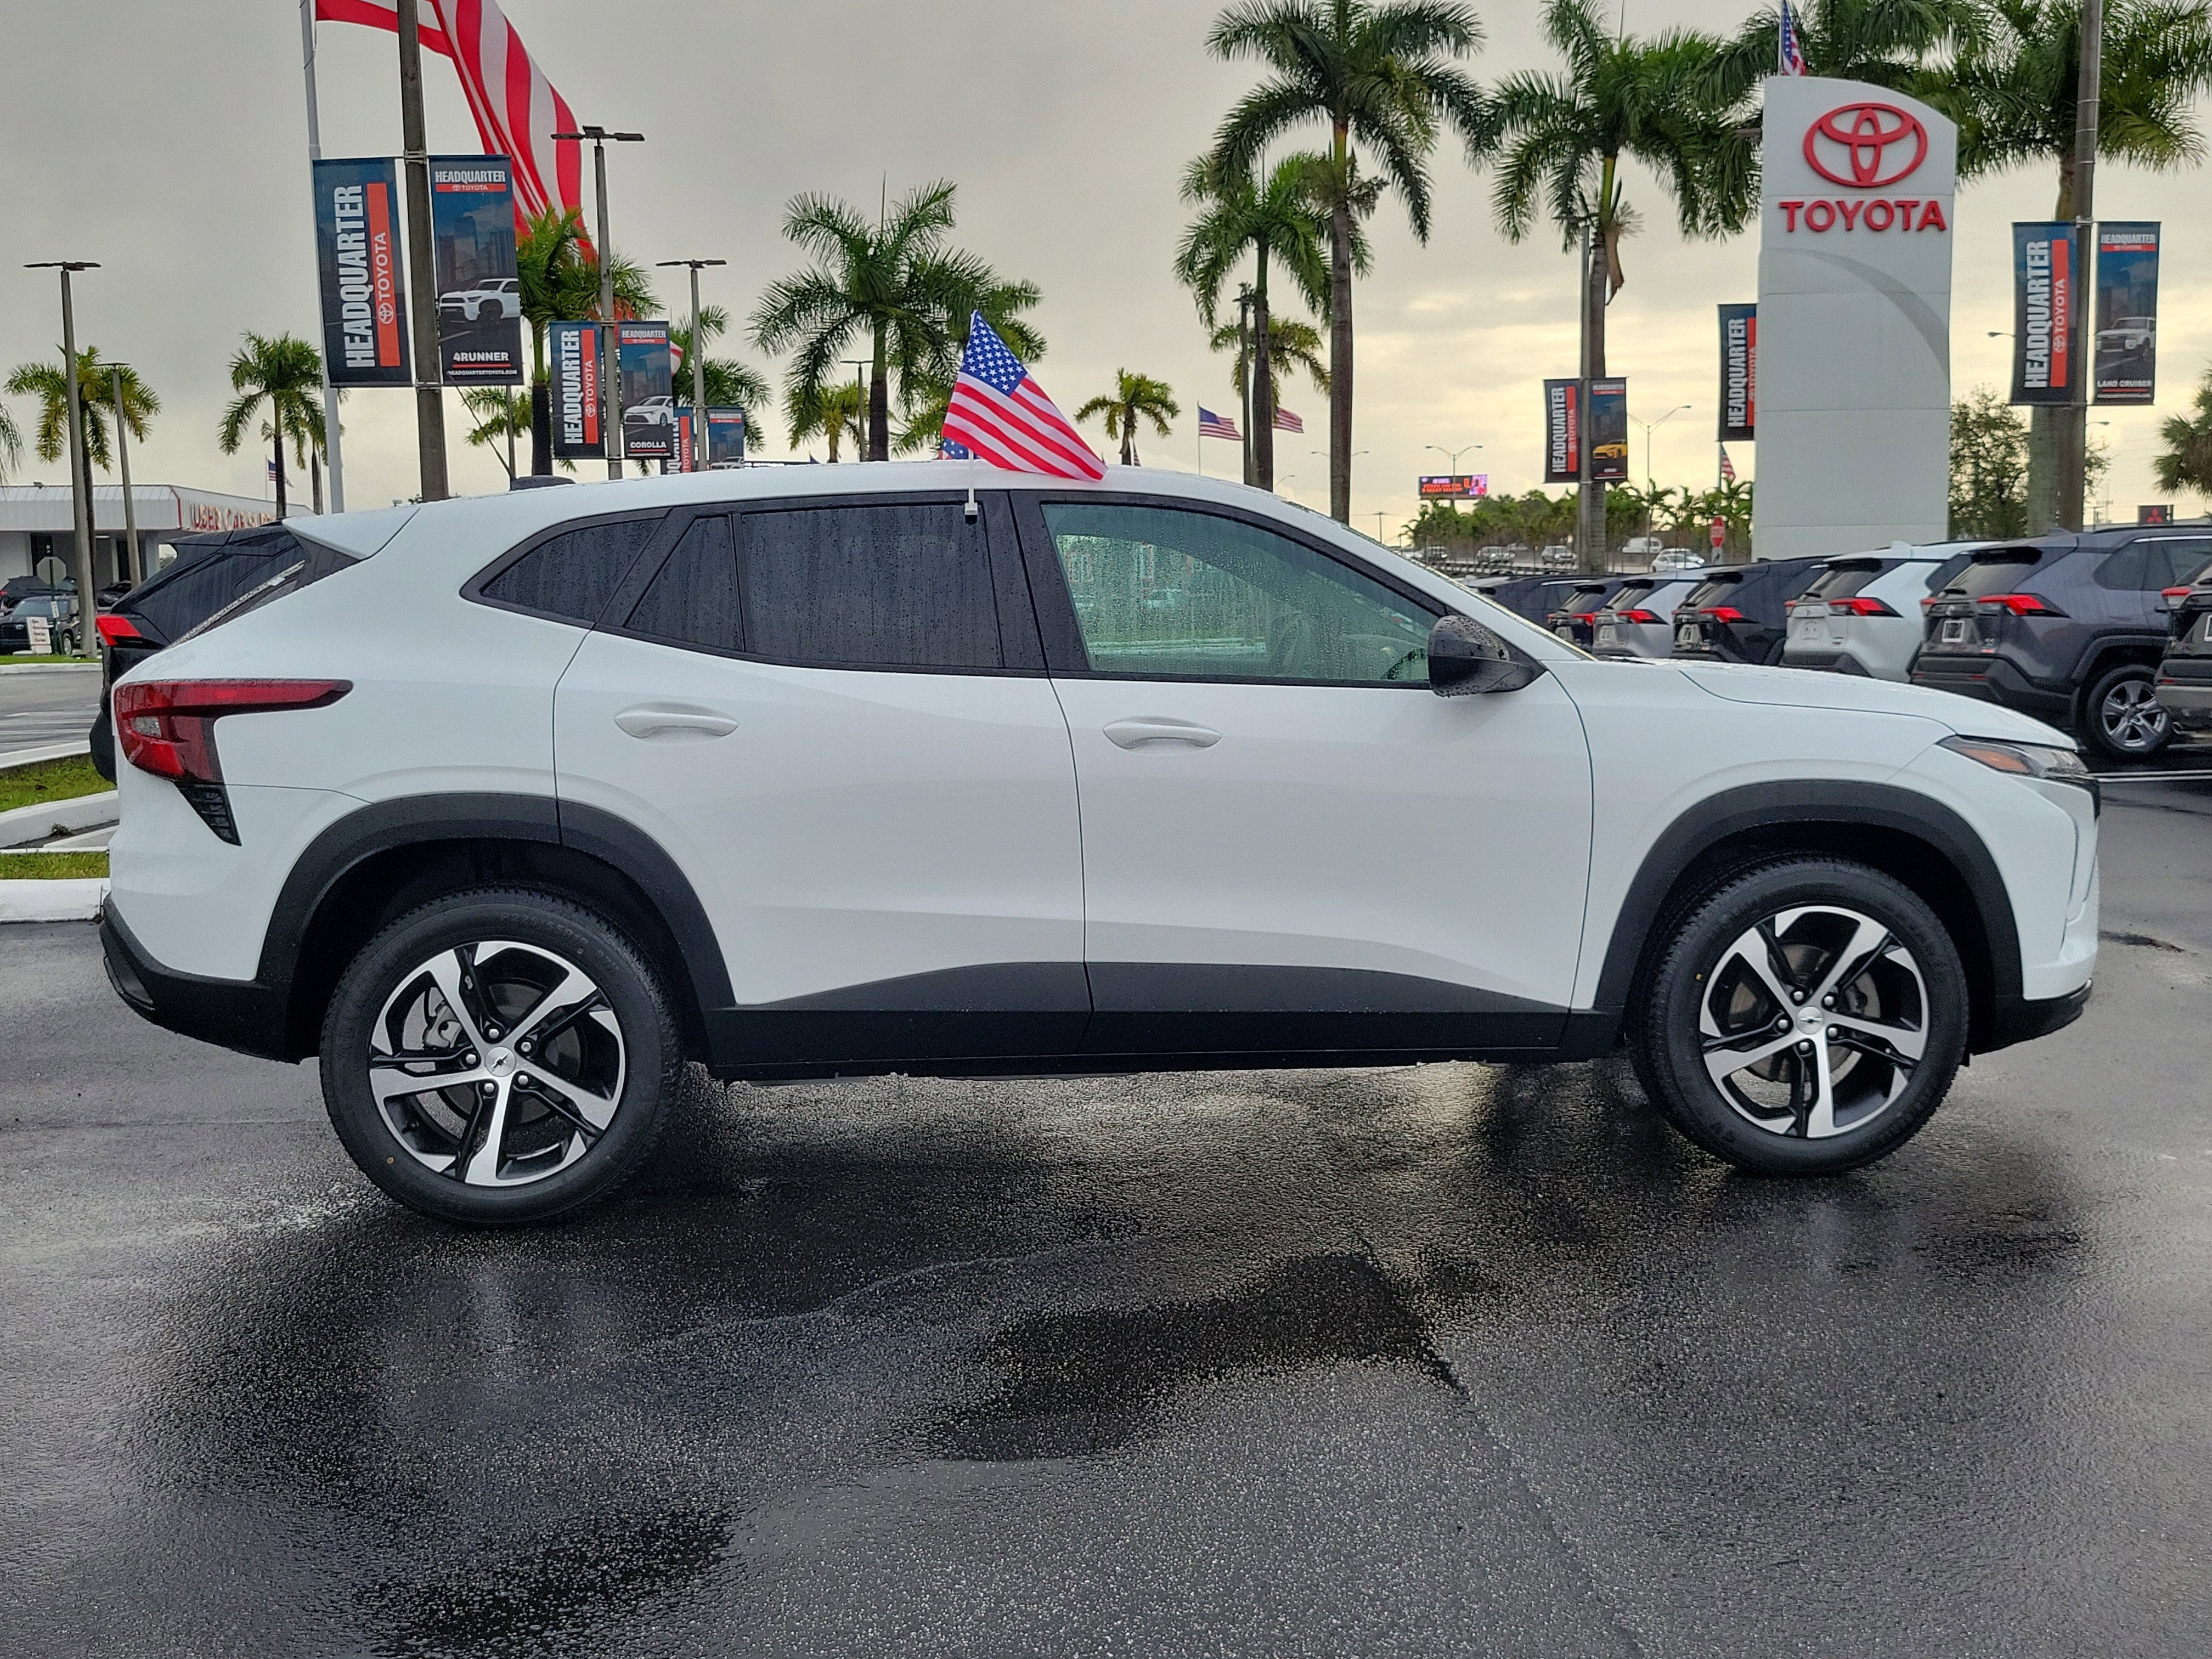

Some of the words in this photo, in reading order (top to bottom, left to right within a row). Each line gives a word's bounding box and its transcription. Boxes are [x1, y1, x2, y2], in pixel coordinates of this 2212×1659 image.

[435, 170, 506, 184] HEADQUARTER
[1779, 200, 1947, 232] TOYOTA
[2101, 234, 2155, 245] HEADQUARTER
[334, 185, 376, 368] HEADQUARTER
[374, 232, 391, 301] TOYOTA
[2024, 241, 2052, 388] HEADQUARTER
[2055, 278, 2066, 333] TOYOTA
[453, 352, 510, 362] 4RUNNER
[561, 330, 584, 444] HEADQUARTER
[585, 360, 594, 402] TOYOTA
[1728, 318, 1748, 427] HEADQUARTER
[1551, 387, 1567, 472] HEADQUARTER
